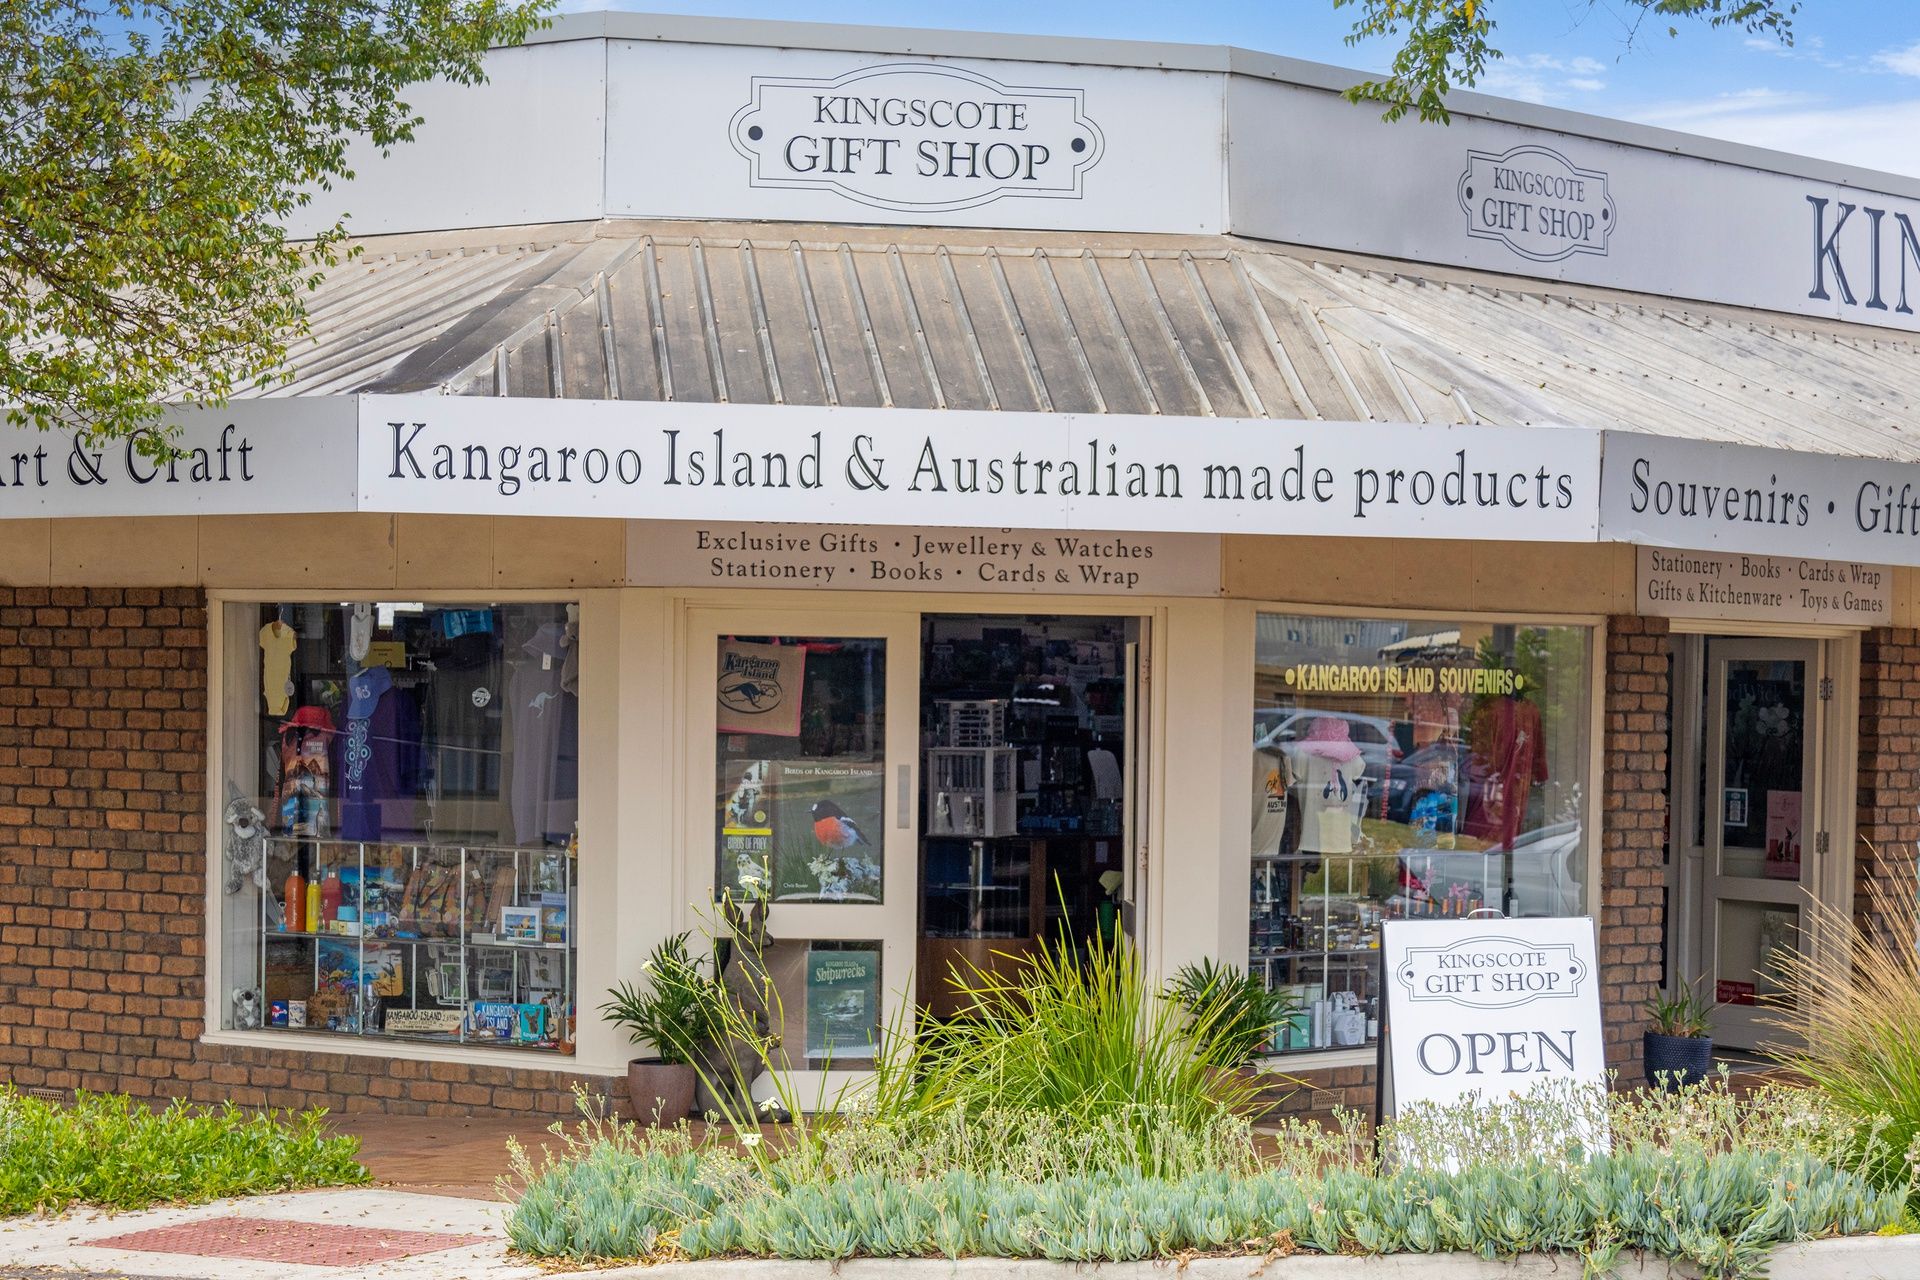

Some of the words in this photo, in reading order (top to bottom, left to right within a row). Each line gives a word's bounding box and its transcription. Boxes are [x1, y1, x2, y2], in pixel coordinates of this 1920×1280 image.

[813, 95, 1029, 131] KINGSCOTE
[783, 135, 900, 175] GIFT
[916, 140, 1050, 181] SHOP
[1493, 166, 1585, 203] KINGSCOTE
[1482, 198, 1532, 232] GIFT
[1539, 206, 1595, 241] SHOP
[0, 445, 48, 486] rt
[67, 430, 107, 486] &
[125, 424, 254, 484] Craft
[387, 421, 643, 496] Kangaroo
[662, 428, 823, 489] Island
[844, 434, 889, 490] &
[908, 434, 1183, 500] Australian
[1203, 446, 1334, 502] made
[1354, 449, 1573, 518] products
[1630, 457, 1809, 527] Souvenirs
[696, 530, 811, 551] Exclusive
[820, 532, 878, 553] Gifts
[912, 534, 1022, 560] Jewellery
[1032, 541, 1047, 556] &
[1055, 537, 1153, 559] Watches
[711, 557, 836, 583] Stationery
[870, 560, 943, 581] Books
[978, 562, 1046, 583] Cards
[1055, 567, 1070, 583] &
[1078, 564, 1139, 589] Wrap
[1652, 550, 1722, 576] Stationery
[1741, 556, 1780, 578] Books
[1799, 561, 1834, 582] Cards
[1839, 569, 1846, 583] &
[1850, 564, 1881, 589] Wrap
[1648, 579, 1682, 601] Gifts
[1686, 586, 1695, 600] &
[1699, 582, 1782, 607] Kitchenware
[1800, 588, 1828, 613] Toys
[1832, 596, 1840, 610] &
[1843, 590, 1883, 612] Games
[725, 653, 780, 672] Kangaroo
[742, 668, 777, 680] Island
[1296, 664, 1380, 692] KANGAROO
[1384, 667, 1435, 694] ISLAND
[1439, 668, 1514, 695] SOUVENIRS
[1438, 952, 1547, 969] KINGSCOTE
[1425, 974, 1484, 994] GIFT
[1491, 971, 1561, 993] SHOP
[481, 1005, 512, 1017] KANGAROO
[485, 1017, 509, 1030] ISLAND
[1417, 1030, 1577, 1075] OPEN
